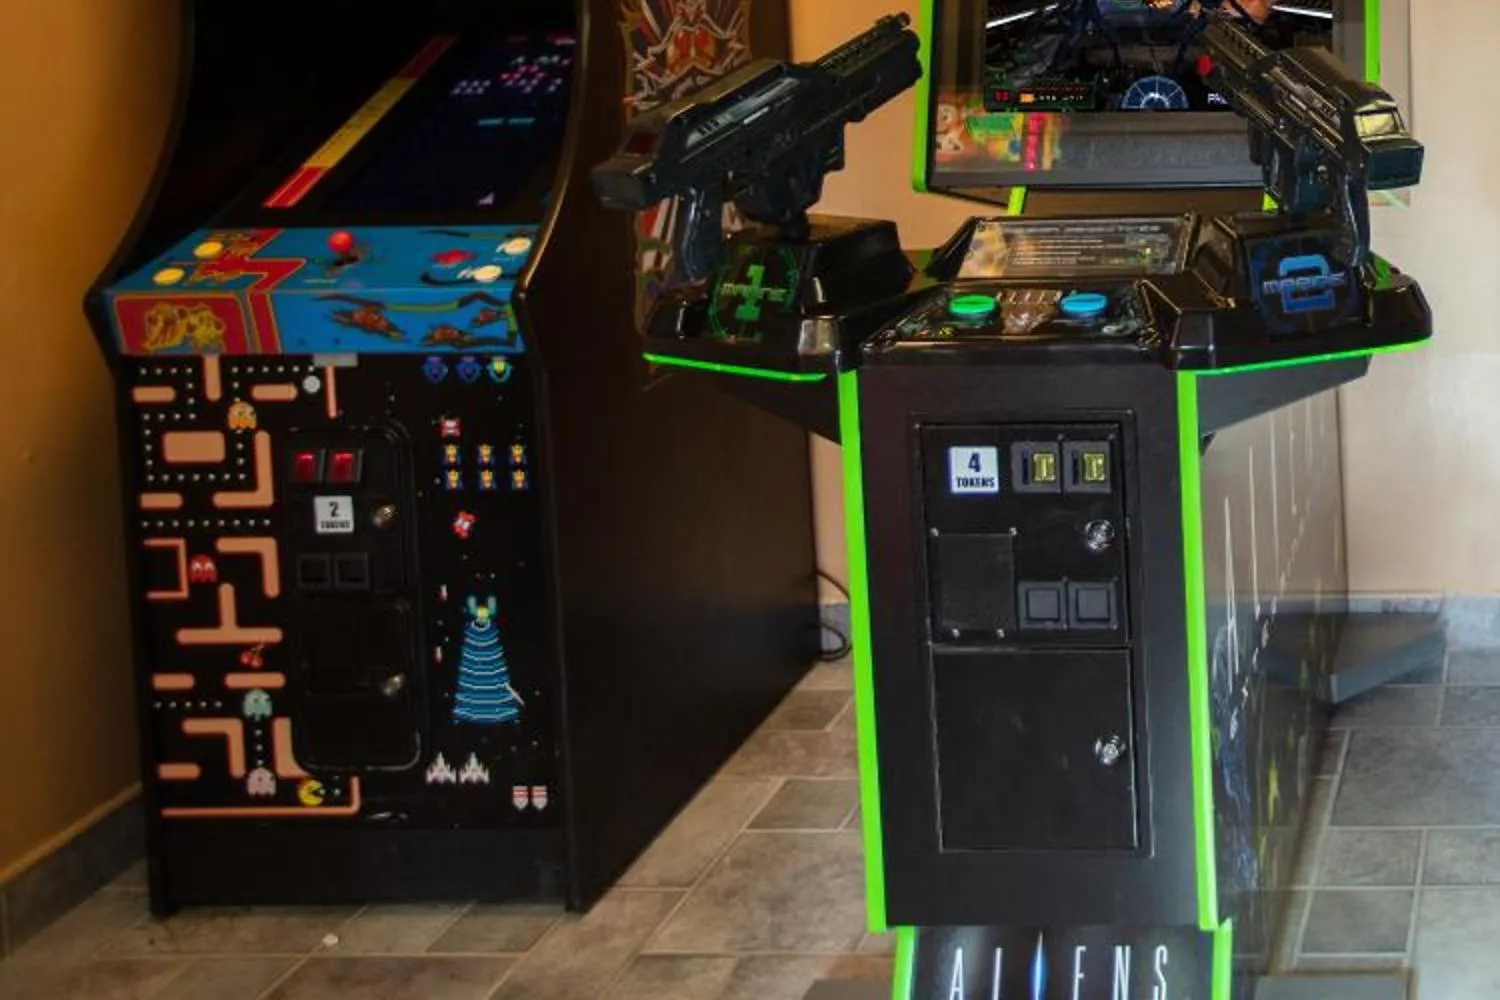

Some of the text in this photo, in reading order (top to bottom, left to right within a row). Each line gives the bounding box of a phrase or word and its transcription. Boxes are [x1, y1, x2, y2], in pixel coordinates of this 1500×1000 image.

[968, 452, 982, 473] 4
[957, 476, 995, 488] TOKENS
[328, 500, 341, 518] 2
